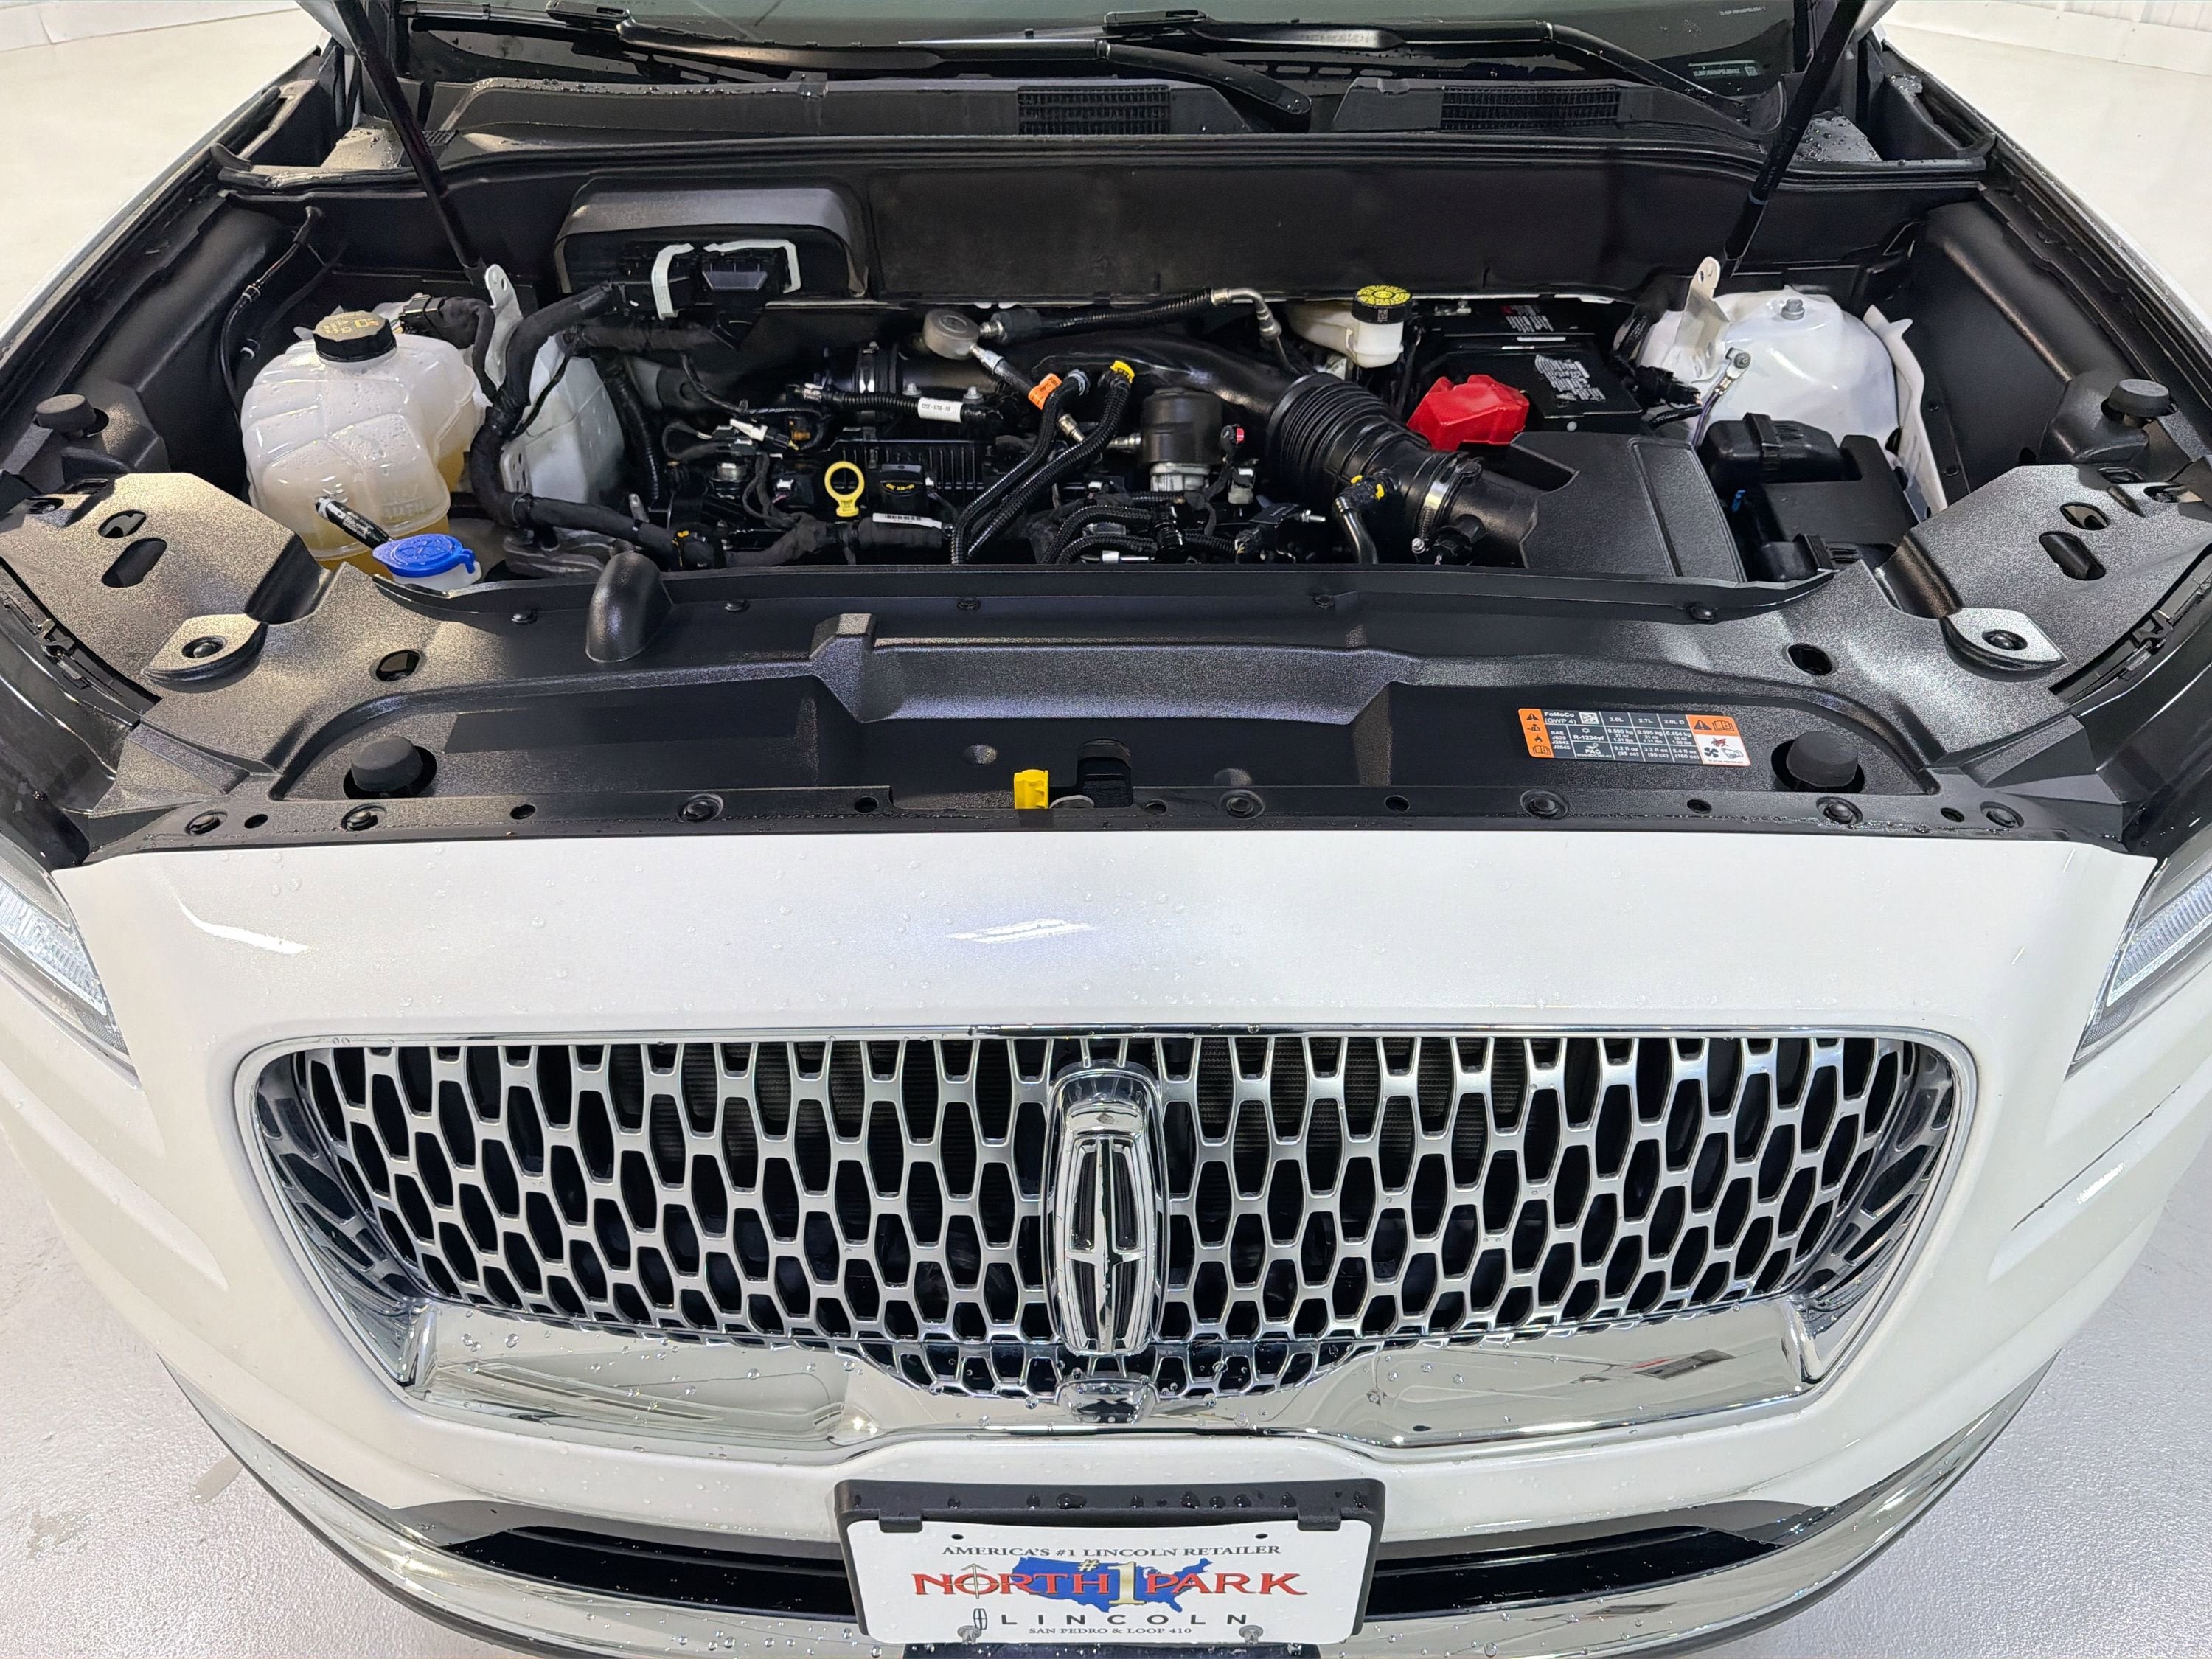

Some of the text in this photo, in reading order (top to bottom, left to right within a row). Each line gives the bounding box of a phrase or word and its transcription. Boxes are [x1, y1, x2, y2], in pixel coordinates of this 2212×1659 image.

[942, 1547, 1050, 1556] AMERICA'S
[1084, 1548, 1177, 1557] LINCOLN
[1183, 1545, 1281, 1556] RETAILER
[913, 1572, 1308, 1596] NORTH PARK
[1001, 1614, 1247, 1625] LINCOLN
